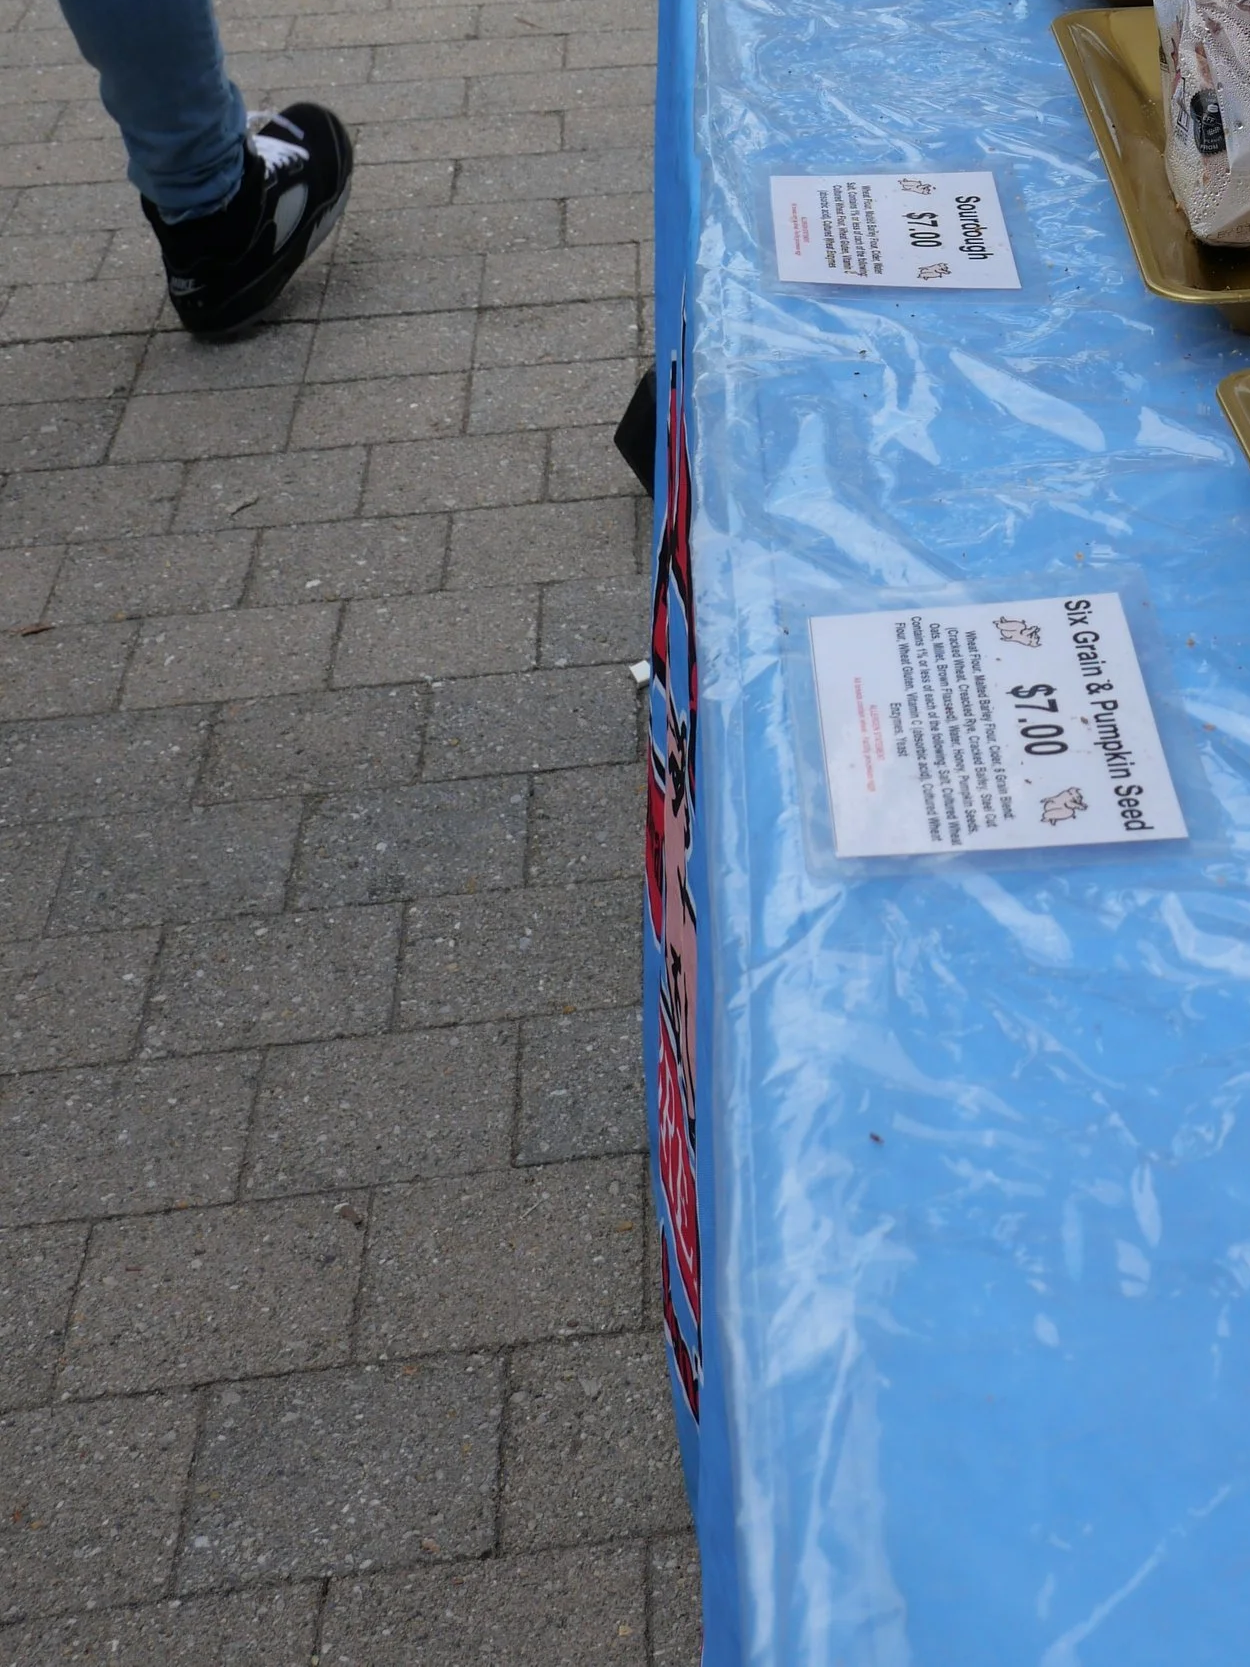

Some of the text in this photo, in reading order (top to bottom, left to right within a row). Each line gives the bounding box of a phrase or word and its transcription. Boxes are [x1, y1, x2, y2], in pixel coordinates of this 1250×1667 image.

[902, 212, 942, 248] $7.00
[955, 195, 994, 261] Sourdough
[1010, 683, 1068, 756] $7.00
[1064, 599, 1154, 831] Six Grain & Pumpkin Seed
